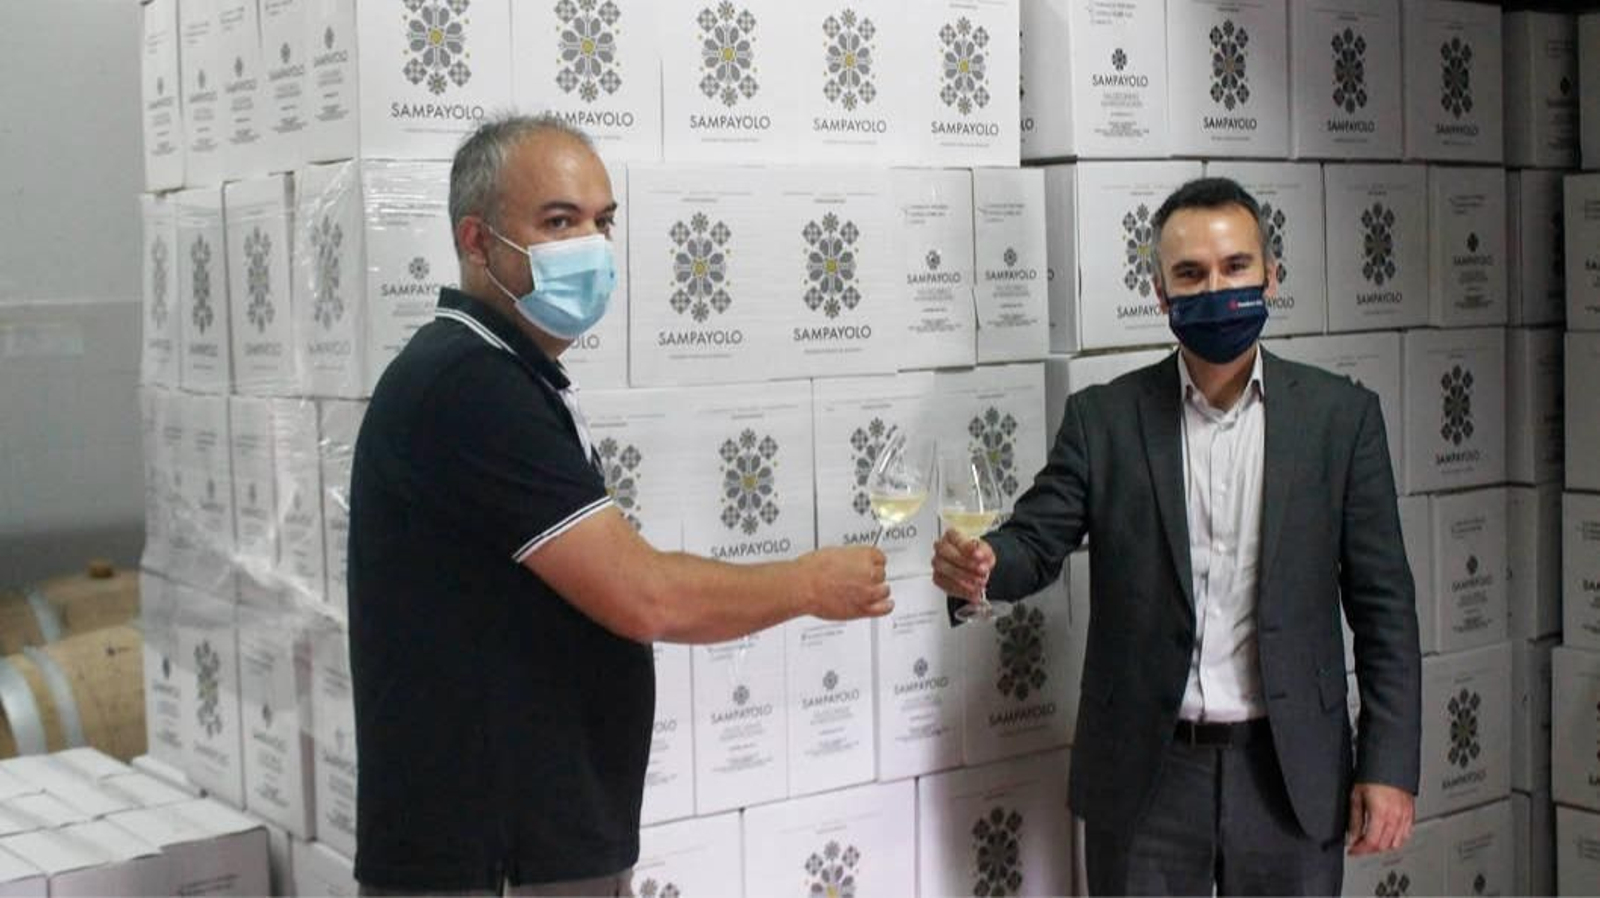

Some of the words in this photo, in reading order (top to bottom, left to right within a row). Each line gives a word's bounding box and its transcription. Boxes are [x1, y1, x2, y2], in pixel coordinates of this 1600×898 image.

[1092, 74, 1149, 87] SAMPAYOLO
[391, 102, 485, 121] SAMPAYOLO
[690, 115, 771, 130] SAMPAYOLO
[813, 118, 887, 134] SAMPAYOLO
[931, 121, 999, 136] SAMPAYOLO
[1203, 117, 1257, 130] SAMPAYOLO
[1327, 120, 1375, 133] SAMPAYOLO
[907, 271, 961, 285] SAMPAYOLO
[985, 269, 1037, 281] SAMPAYOLO
[1117, 303, 1161, 319] SAMPAYO
[658, 330, 743, 346] SAMPAYOLO
[793, 325, 871, 341] SAMPAYOLO
[711, 538, 791, 558] SAMPAYOLO
[802, 688, 860, 709] SAMPAYOLO
[711, 704, 773, 725] SAMPAYOLO
